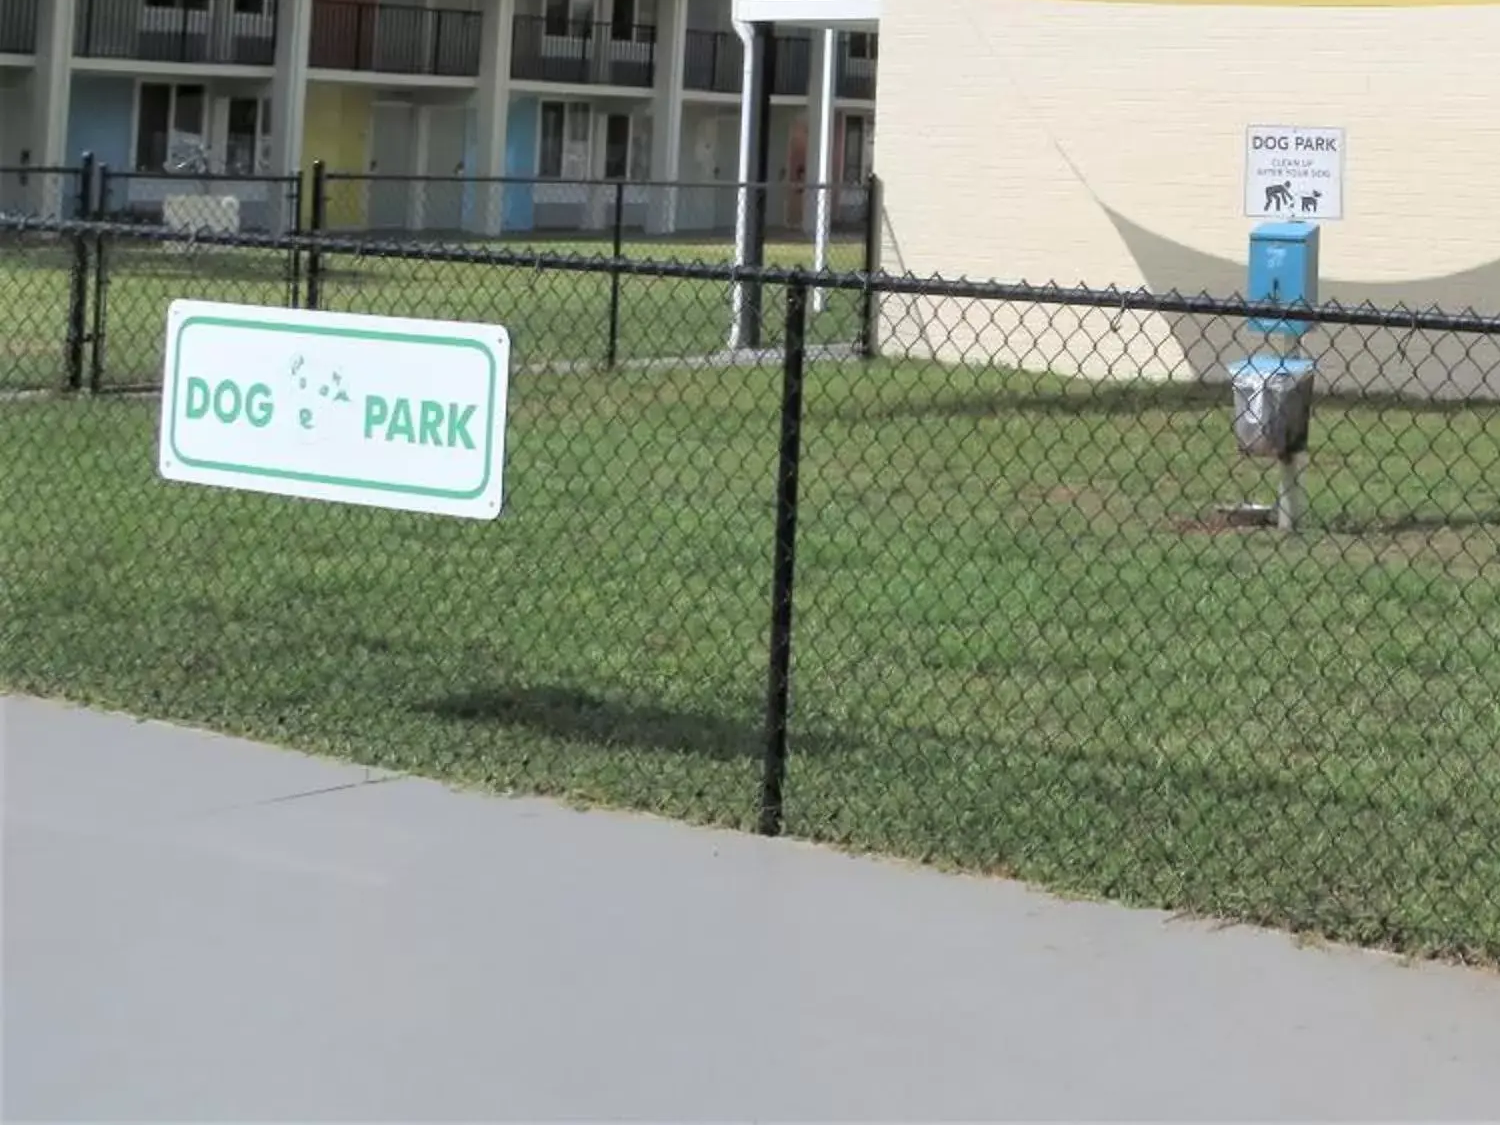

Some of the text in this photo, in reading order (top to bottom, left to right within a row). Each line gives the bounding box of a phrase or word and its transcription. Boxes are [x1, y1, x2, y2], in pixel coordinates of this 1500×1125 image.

[1252, 136, 1337, 152] DOG PARK
[185, 377, 478, 450] DOG PARK
